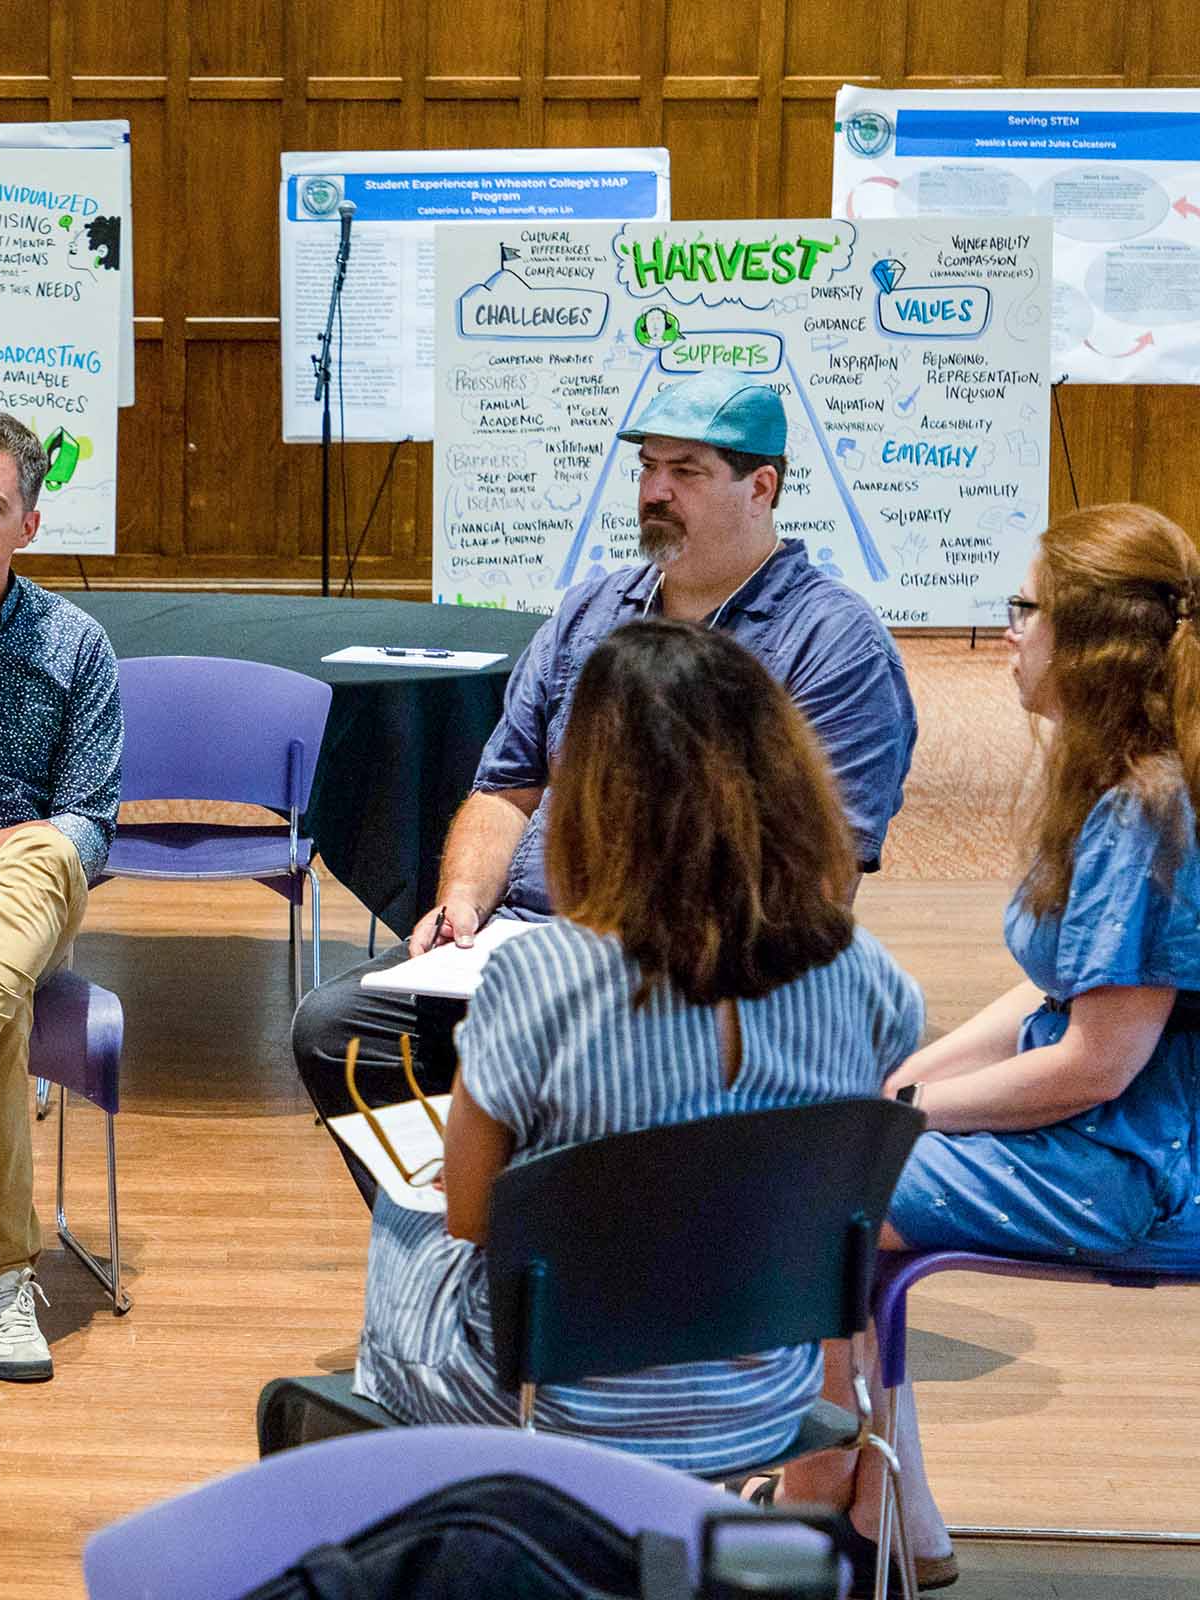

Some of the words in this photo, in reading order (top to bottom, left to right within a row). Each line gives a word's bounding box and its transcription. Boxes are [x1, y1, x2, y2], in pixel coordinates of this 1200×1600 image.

[1008, 116, 1048, 128] Serving
[1050, 116, 1080, 126] STEM
[1030, 139, 1047, 148] and
[365, 179, 410, 190] Student
[412, 179, 479, 192] Experiences
[481, 179, 493, 190] in
[495, 179, 547, 190] Wheaton
[549, 178, 599, 192] College's
[601, 178, 629, 188] MAP
[471, 191, 521, 203] Program
[520, 230, 572, 243] CULTURAL
[951, 234, 1030, 253] VULNERABILITY
[530, 243, 592, 255] DIFFERENCES
[632, 235, 833, 289] HARVEST
[944, 254, 1018, 268] COMPASSION
[35, 280, 82, 302] NEEDS
[811, 286, 864, 301] DIVERSITY
[475, 304, 593, 328] CHALLENGES
[895, 298, 974, 325] VALUES
[804, 316, 867, 332] GUIDANCE
[672, 343, 770, 367] SUPPORTS
[829, 353, 899, 373] INSPIRATION
[2, 370, 71, 389] AVAILABLE
[454, 368, 528, 392] PRESSURES
[809, 373, 864, 386] COURAGE
[945, 385, 1006, 404] INCLUSION
[479, 397, 529, 411] FAMILIAL
[825, 398, 885, 415] VALIDATION
[479, 413, 545, 428] ACADEMIC
[453, 452, 520, 471] BARRIERS
[881, 439, 980, 469] EMPATHY
[853, 479, 920, 493] AWARENESS
[959, 484, 1019, 499] HUMILITY
[880, 508, 952, 527] SOLIDARITY
[450, 520, 506, 537] FINANCIAL
[512, 519, 575, 531] CONSTRAINTS
[940, 536, 993, 548] ACADEMIC
[451, 553, 544, 568] DISCRIMINATION
[945, 549, 1000, 565] FLEXIBILITY
[900, 572, 980, 587] CITIZENSHIP
